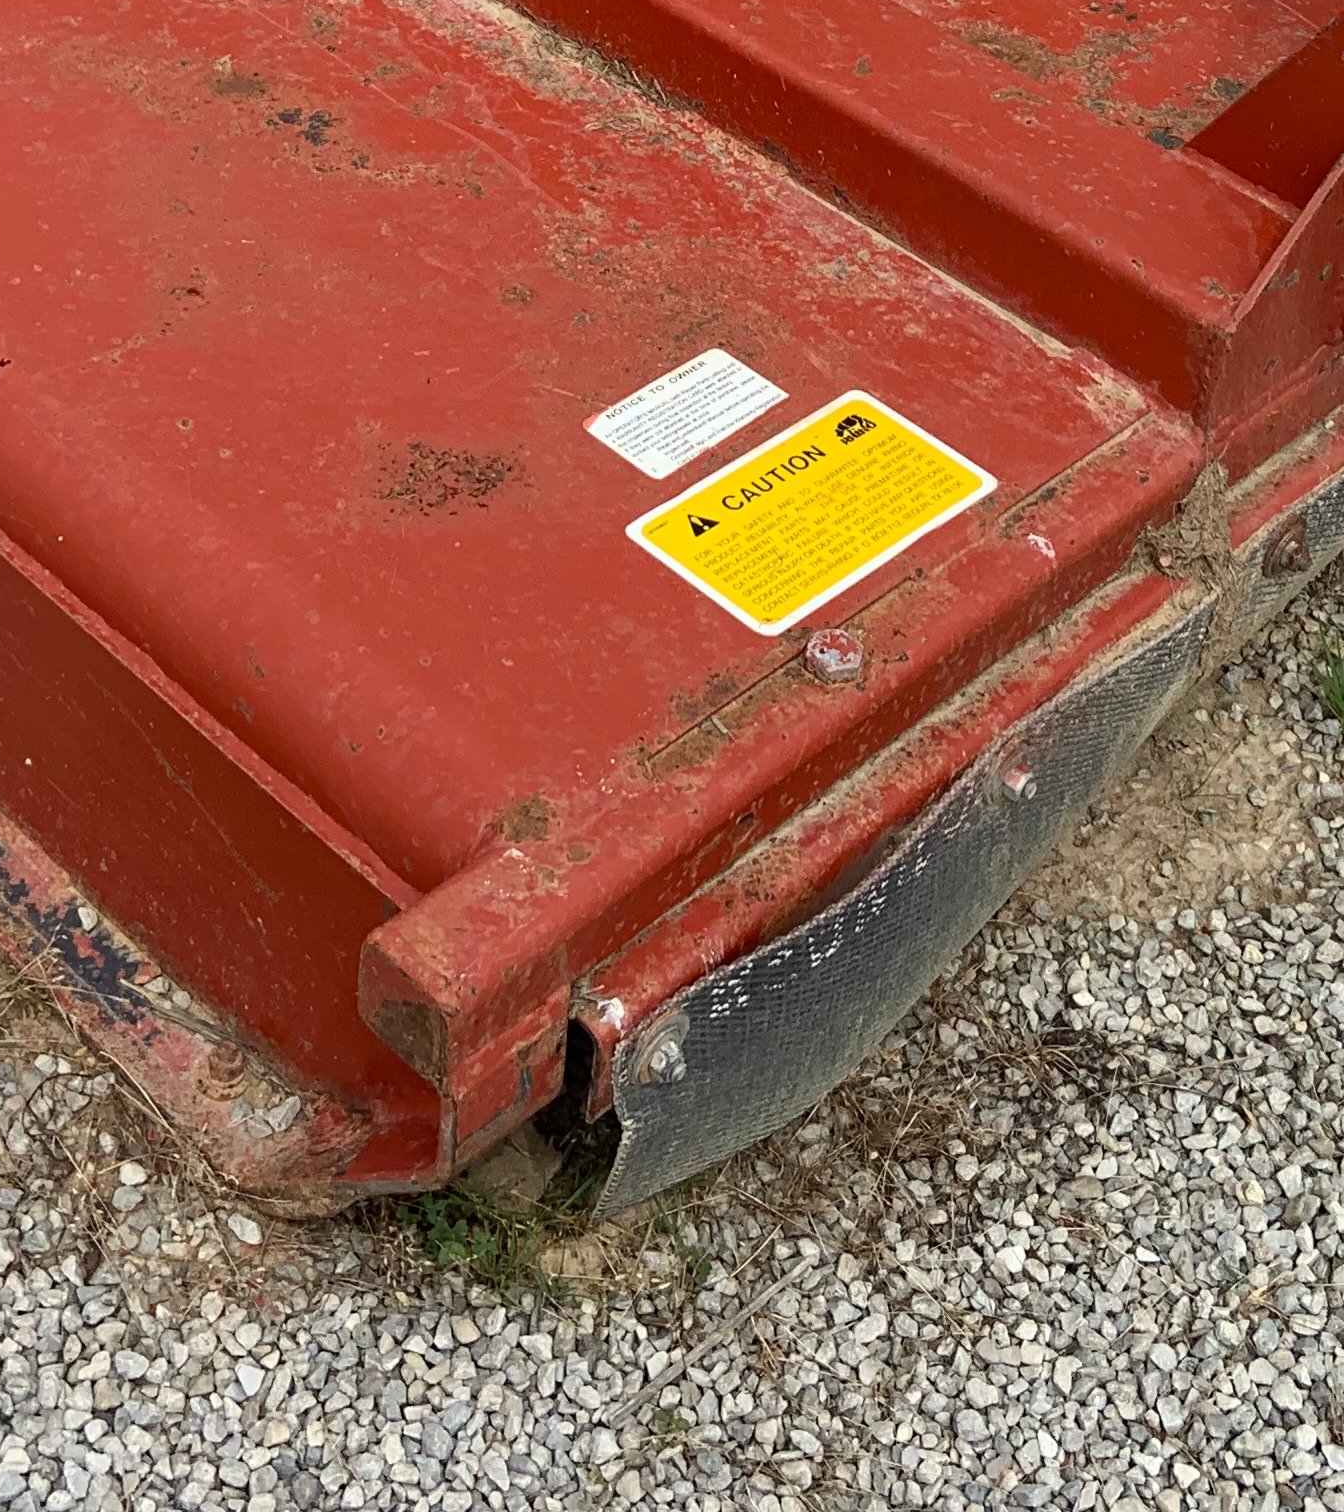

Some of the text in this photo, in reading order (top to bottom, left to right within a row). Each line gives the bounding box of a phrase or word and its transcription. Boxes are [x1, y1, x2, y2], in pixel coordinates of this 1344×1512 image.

[605, 360, 707, 420] NOTICE TO OWNER
[721, 443, 827, 513] CAUTION
[797, 486, 812, 496] TO
